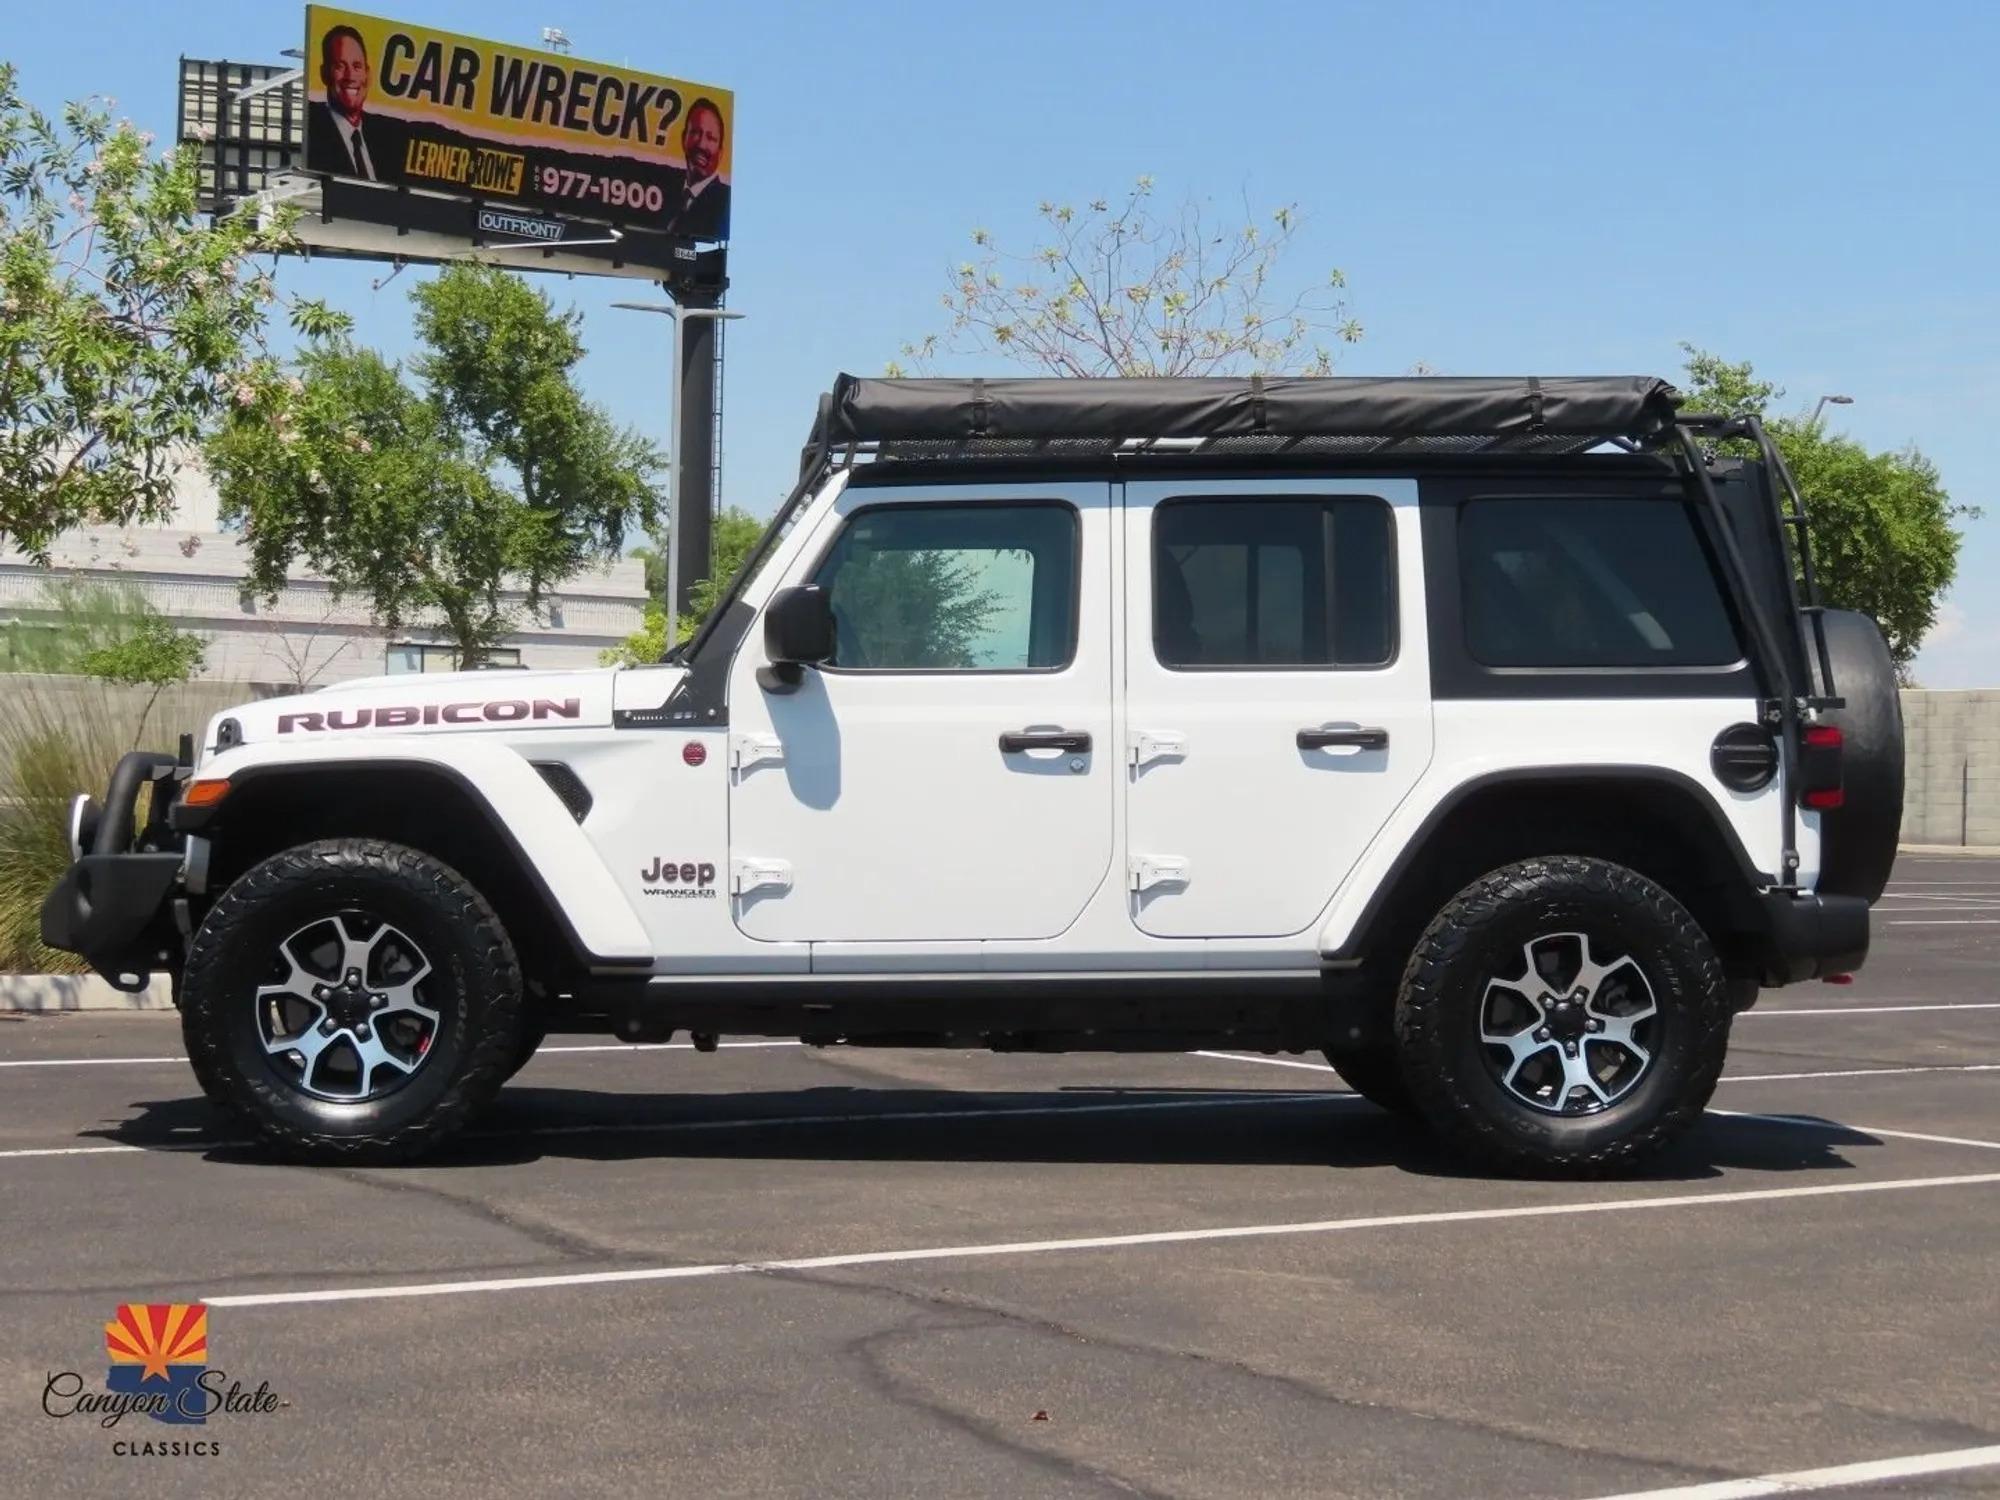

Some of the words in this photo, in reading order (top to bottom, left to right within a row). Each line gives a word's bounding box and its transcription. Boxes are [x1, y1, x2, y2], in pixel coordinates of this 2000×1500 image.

[379, 33, 481, 110] CAR
[490, 54, 682, 146] WRECK?
[404, 139, 471, 183] LERNER
[474, 150, 523, 192] ROWE
[543, 166, 663, 212] 977-1900
[277, 697, 581, 734] RUBICON
[641, 856, 716, 888] Jeep
[643, 888, 716, 896] WRANGLER
